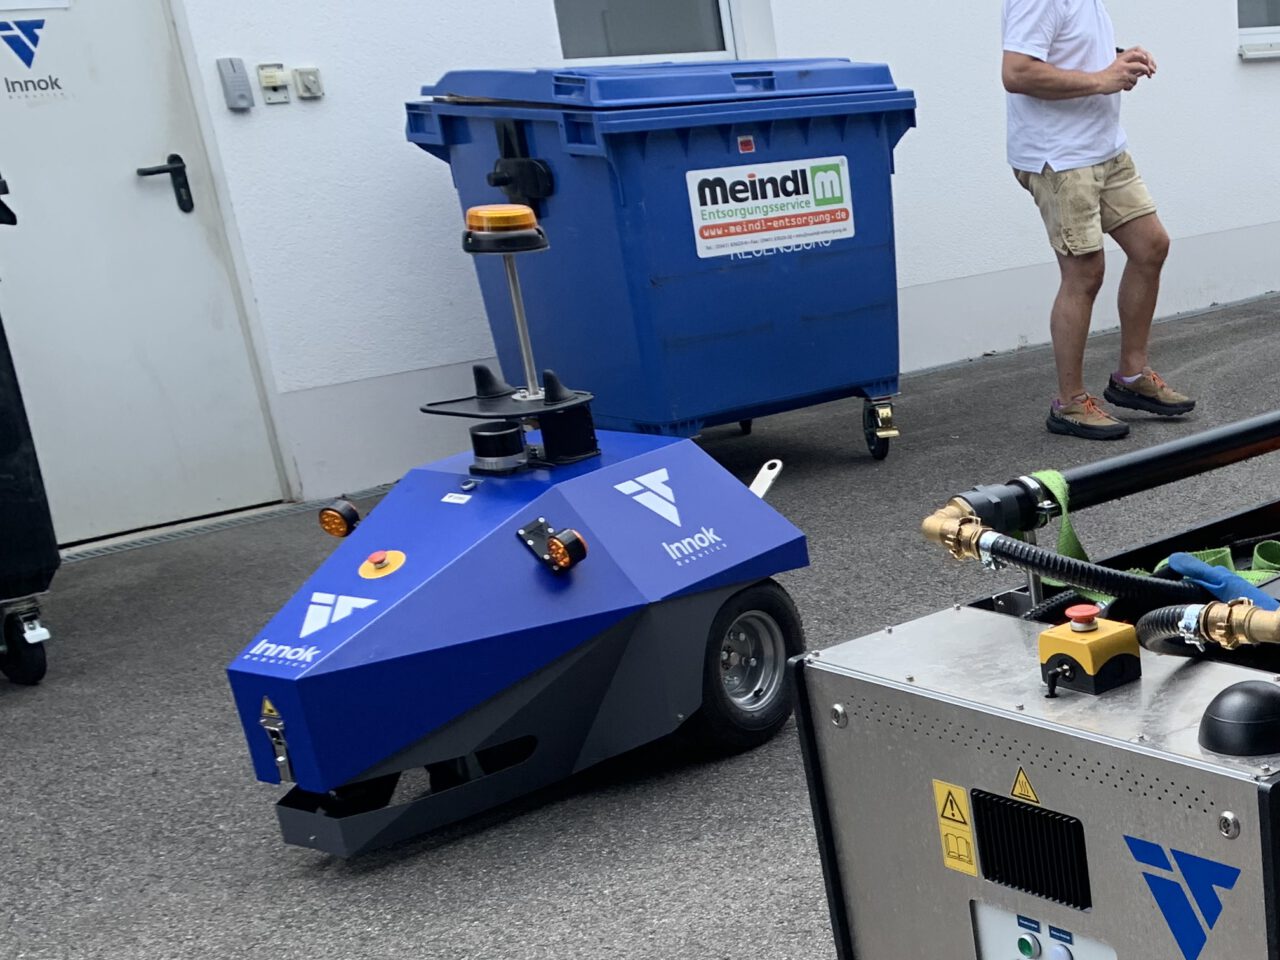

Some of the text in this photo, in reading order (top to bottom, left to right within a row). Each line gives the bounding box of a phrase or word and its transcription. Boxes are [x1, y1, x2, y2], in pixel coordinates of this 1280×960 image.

[4, 74, 62, 93] Innok
[701, 198, 811, 221] Entsorgungsservice
[703, 210, 847, 237] www.meindl-entsorgung.de
[662, 526, 722, 560] Innok
[249, 638, 321, 662] Innok
